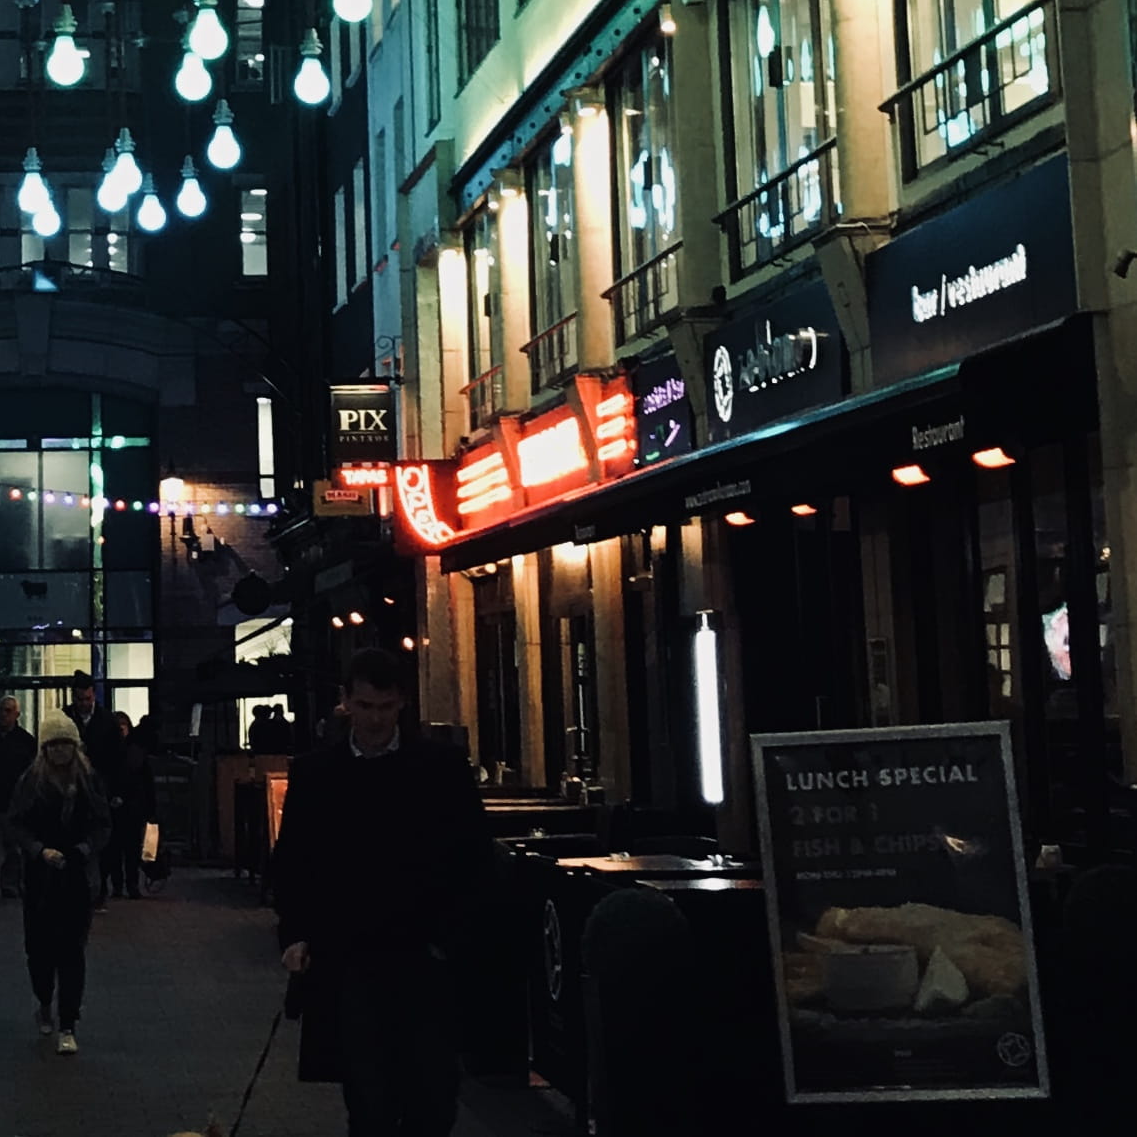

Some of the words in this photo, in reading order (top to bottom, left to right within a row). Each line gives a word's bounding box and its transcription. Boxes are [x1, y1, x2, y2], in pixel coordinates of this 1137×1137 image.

[337, 409, 389, 432] PIX
[912, 414, 965, 451] Restaurant
[786, 769, 869, 792] LUNCH
[876, 763, 979, 788] SPECIAL
[793, 837, 840, 858] FISH
[874, 832, 940, 854] CHIPS
